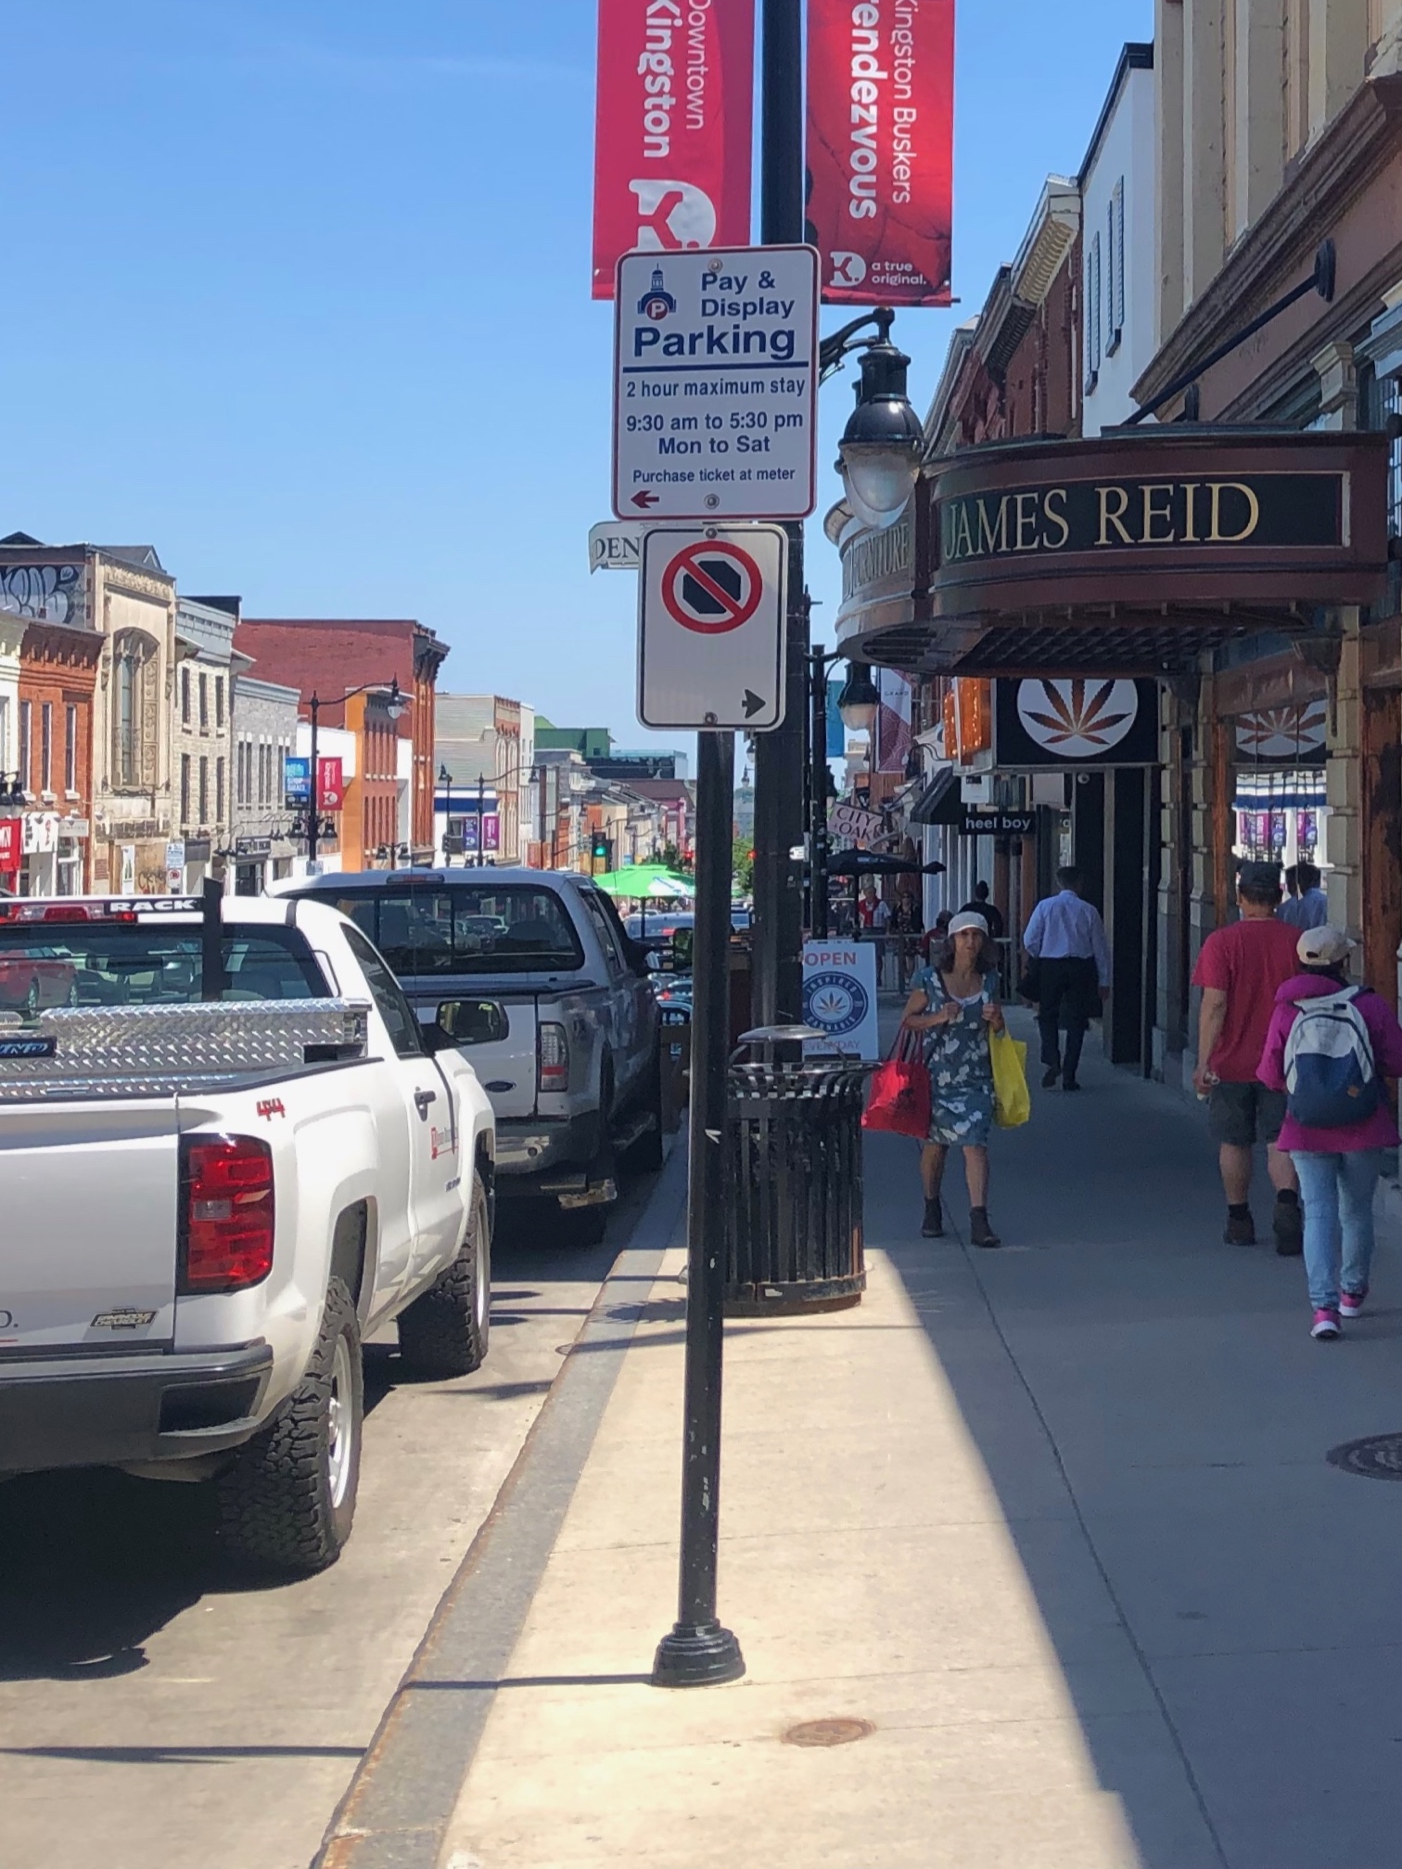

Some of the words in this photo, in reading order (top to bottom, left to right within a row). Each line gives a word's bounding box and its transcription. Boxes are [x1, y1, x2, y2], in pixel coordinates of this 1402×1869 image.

[892, 107, 917, 203] Buskers
[871, 262, 881, 272] a
[884, 260, 913, 272] true
[701, 271, 748, 295] Pay
[758, 270, 776, 289] &
[871, 273, 927, 287] original.
[650, 301, 665, 318] P
[701, 297, 795, 320] Display
[634, 324, 795, 361] Parking
[627, 381, 636, 398] 2
[641, 380, 679, 397] hour
[684, 378, 765, 396] maximum
[770, 377, 806, 397] stay
[626, 415, 664, 432] 9:30
[670, 417, 698, 430] am
[705, 413, 723, 430] to
[730, 411, 768, 429] 5:30
[774, 413, 803, 432] pm
[658, 437, 702, 455] Mon
[709, 437, 729, 453] to
[736, 434, 771, 453] Sat
[633, 469, 695, 483] Purchase
[699, 468, 735, 482] ticket
[740, 468, 752, 481] at
[756, 467, 796, 481] meter
[943, 487, 1069, 561] JAMES
[1094, 482, 1259, 545] REID
[836, 806, 876, 827] CITY
[965, 816, 997, 829] heel
[1002, 816, 1031, 832] boy
[110, 900, 195, 913] RACK
[804, 952, 857, 966] OPEN
